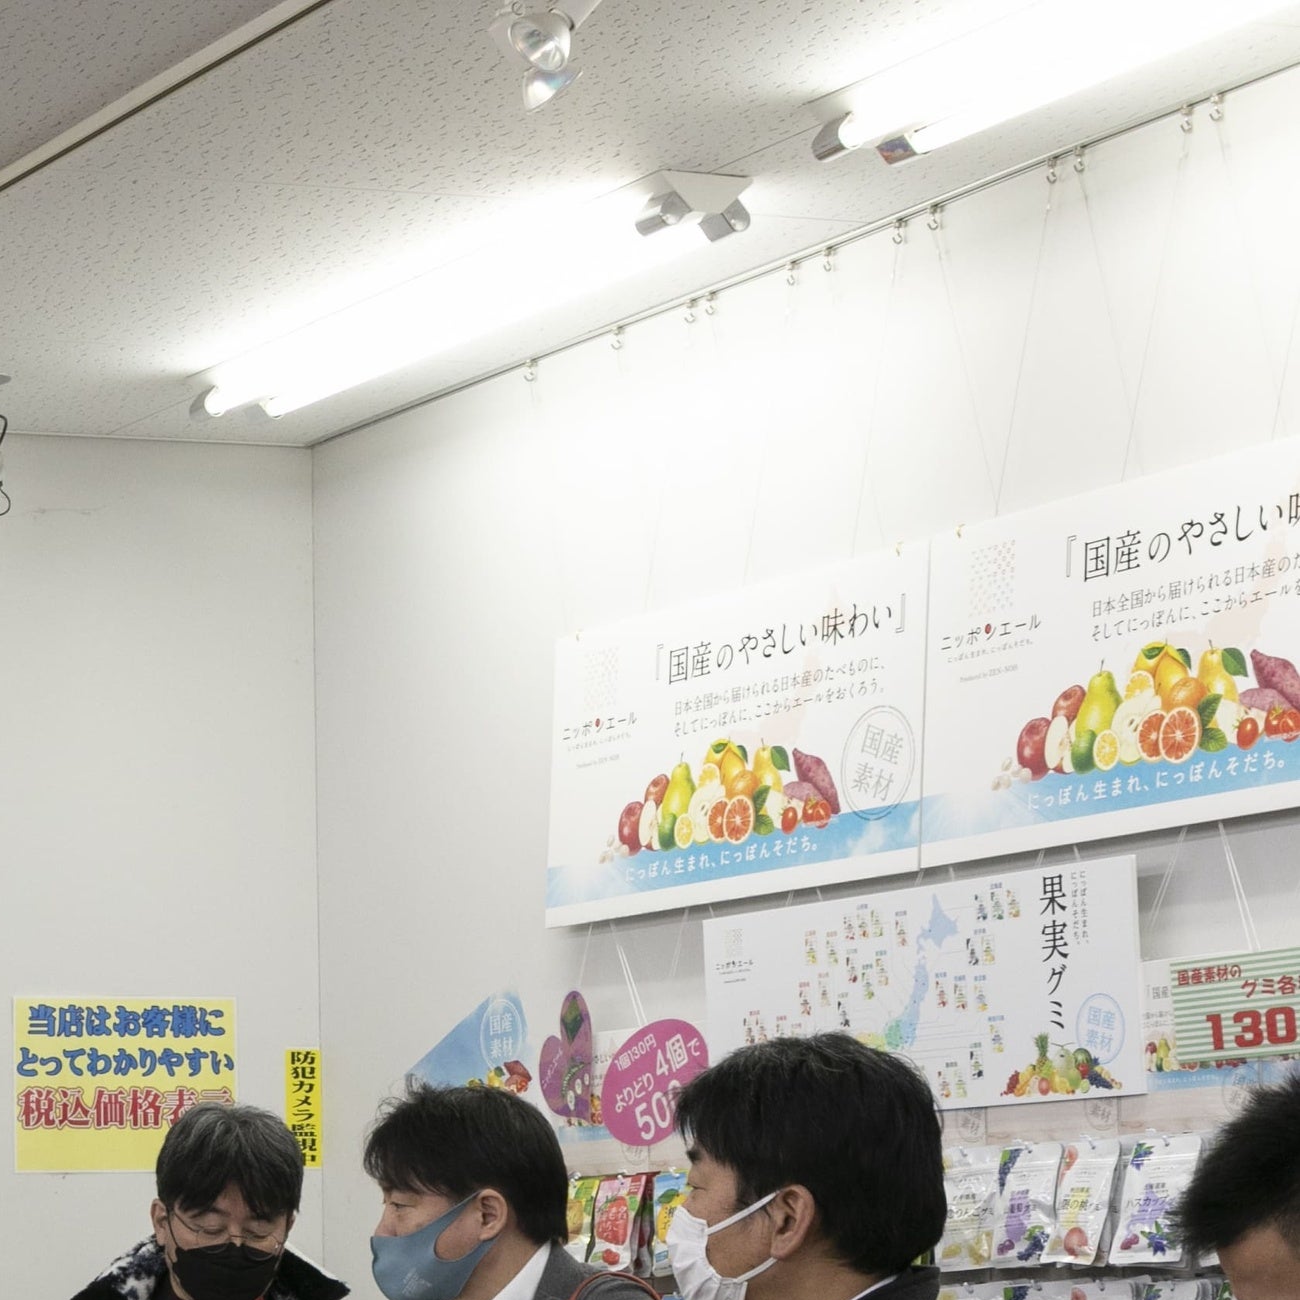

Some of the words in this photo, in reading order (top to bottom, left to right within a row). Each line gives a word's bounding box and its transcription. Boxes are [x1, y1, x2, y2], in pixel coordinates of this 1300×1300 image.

[656, 593, 906, 685] 『国産のやさしい味わい』
[860, 723, 904, 766] 国産
[851, 760, 895, 802] 素材
[1027, 750, 1286, 811] にっぽん生まれ、にっぽんそだち。
[625, 835, 819, 882] にっぽん生まれ、にっぽんそだち。
[1040, 873, 1070, 1029] 果実グミ
[1177, 964, 1242, 987] 国産素材の
[28, 1004, 226, 1038] 当店はお客様に
[488, 1013, 514, 1036] 国産
[1087, 1006, 1116, 1031] 国産
[1206, 1006, 1298, 1051] 130
[489, 1037, 514, 1058] 素材
[614, 1033, 657, 1072] 1個130円
[1086, 1029, 1114, 1053] 素材
[16, 1046, 235, 1078] とってわかりやすい
[614, 1072, 654, 1114] よりどり
[655, 1032, 700, 1077] 4個で
